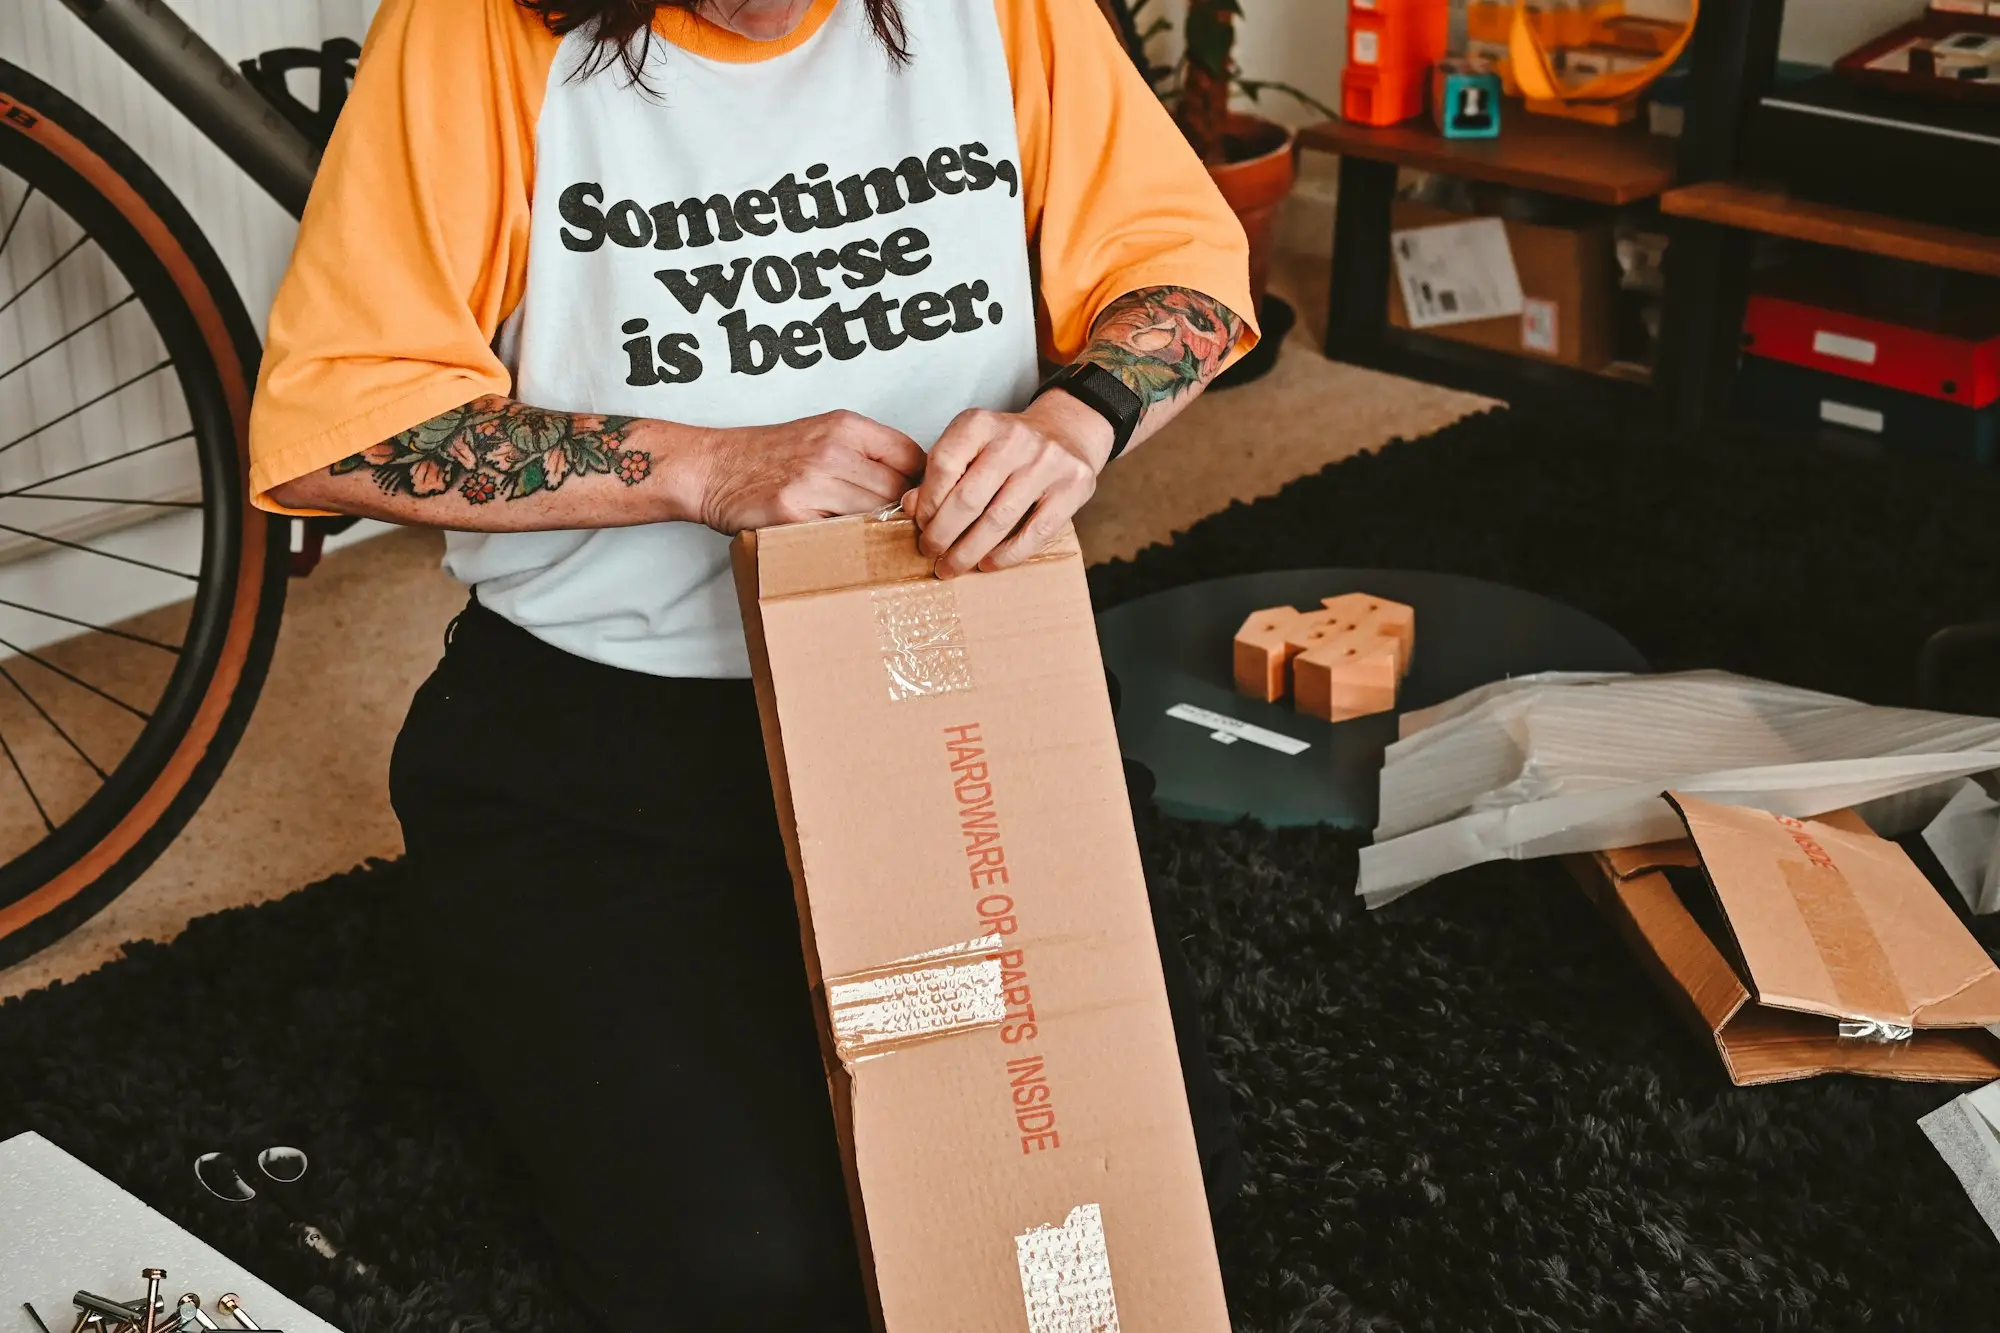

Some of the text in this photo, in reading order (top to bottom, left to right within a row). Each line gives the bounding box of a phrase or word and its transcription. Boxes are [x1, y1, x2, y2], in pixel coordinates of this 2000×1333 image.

[558, 141, 1018, 253] Sometimes,
[654, 227, 932, 314] worse
[621, 279, 1003, 387] is better.
[943, 722, 1061, 1155] HARDWARE OR PARTS INSIDE
